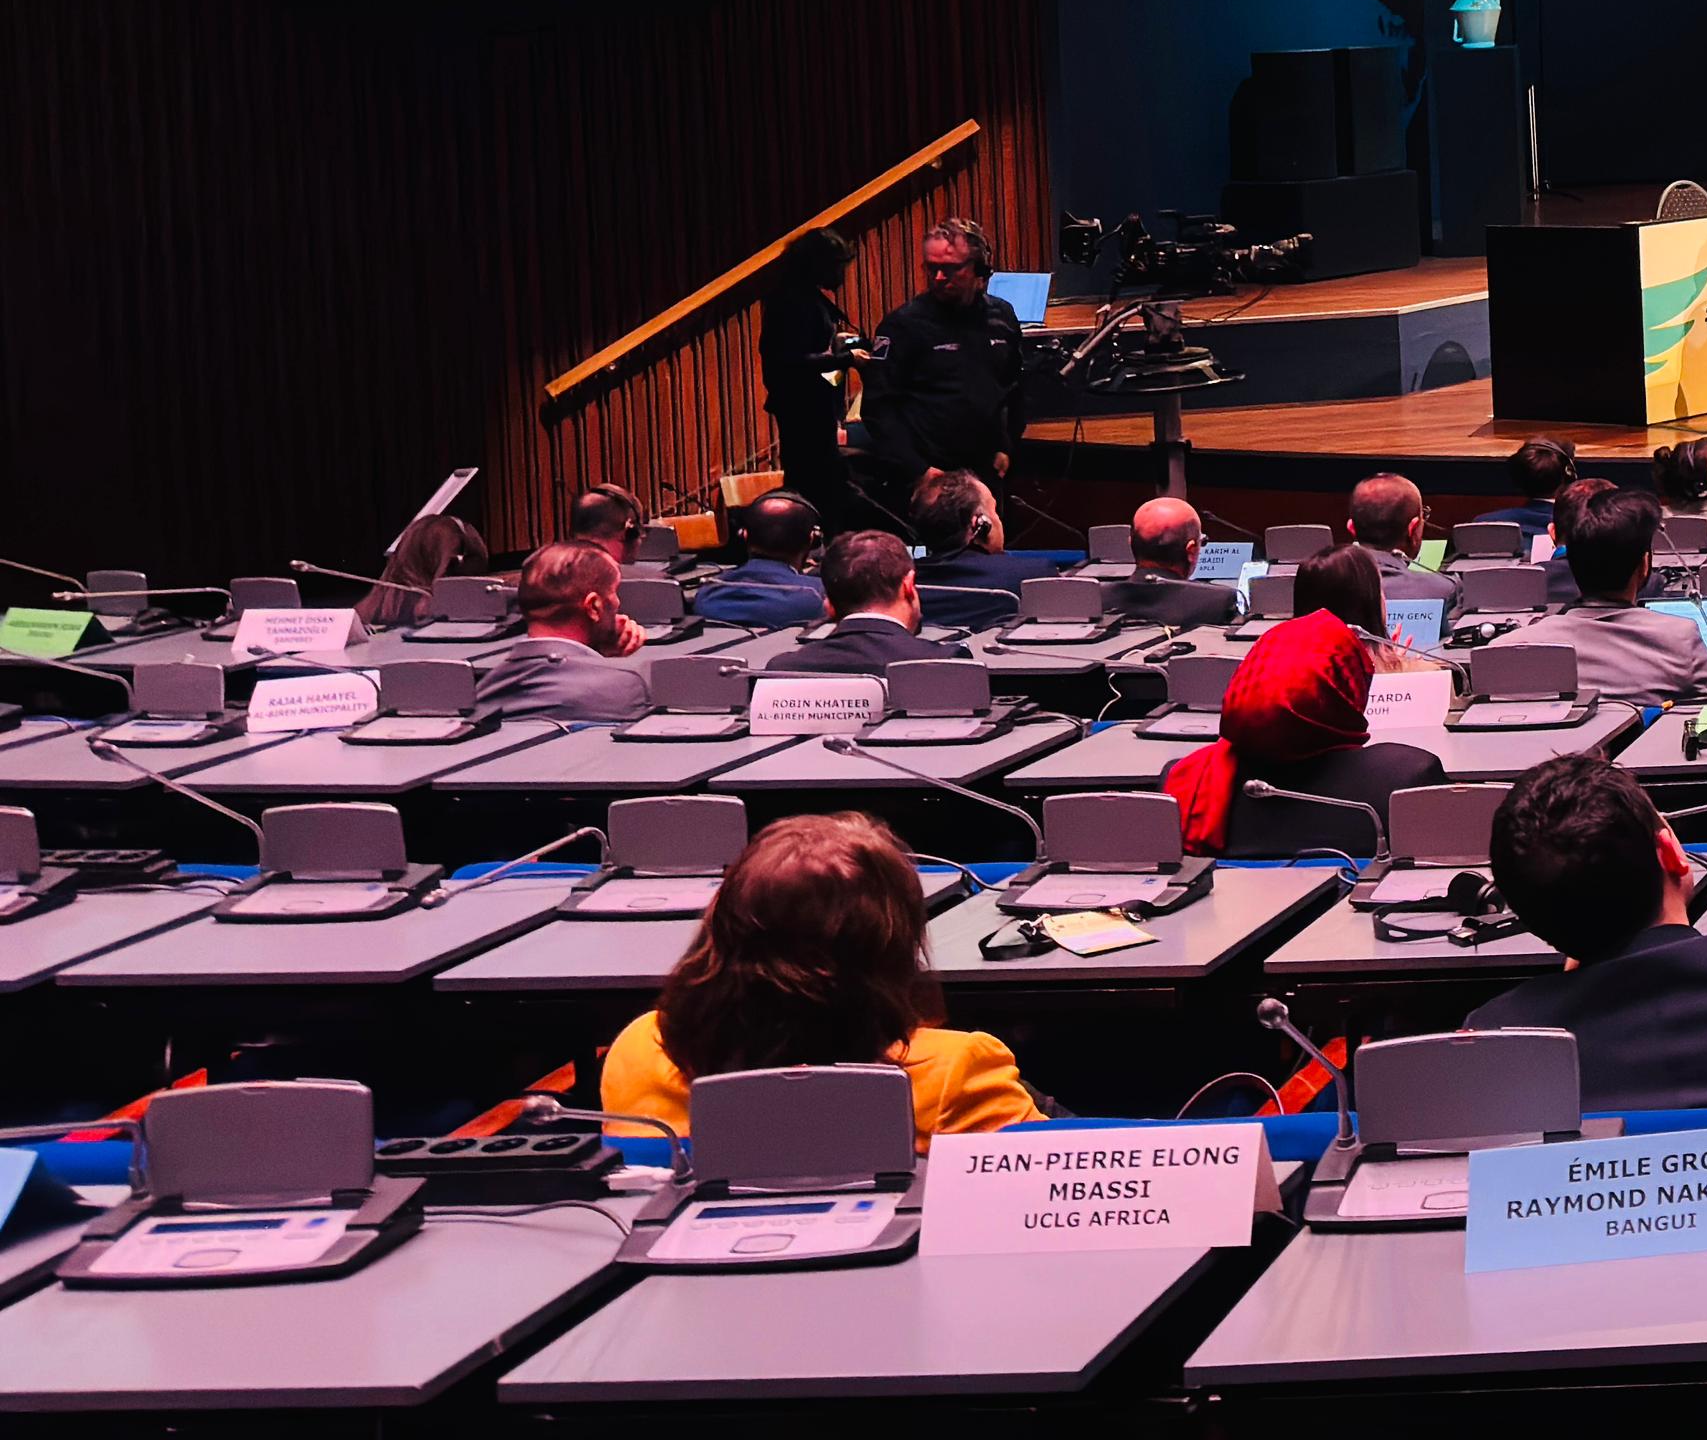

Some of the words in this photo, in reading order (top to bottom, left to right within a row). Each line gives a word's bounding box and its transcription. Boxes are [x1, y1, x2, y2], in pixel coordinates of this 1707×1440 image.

[757, 712, 805, 720] AL-BIREH
[772, 699, 811, 709] ROBIN
[815, 699, 870, 708] KHATEEB
[965, 1149, 1143, 1175] JEAN-PIERRE
[1151, 1146, 1241, 1171] ELONG
[1568, 1153, 1652, 1183] ÉMILE
[1049, 1179, 1152, 1202] MBASSI
[1506, 1186, 1647, 1221] RAYMOND
[1023, 1210, 1083, 1231] UCLG
[1088, 1207, 1171, 1228] AFRICA
[1605, 1212, 1698, 1237] BANGUI
